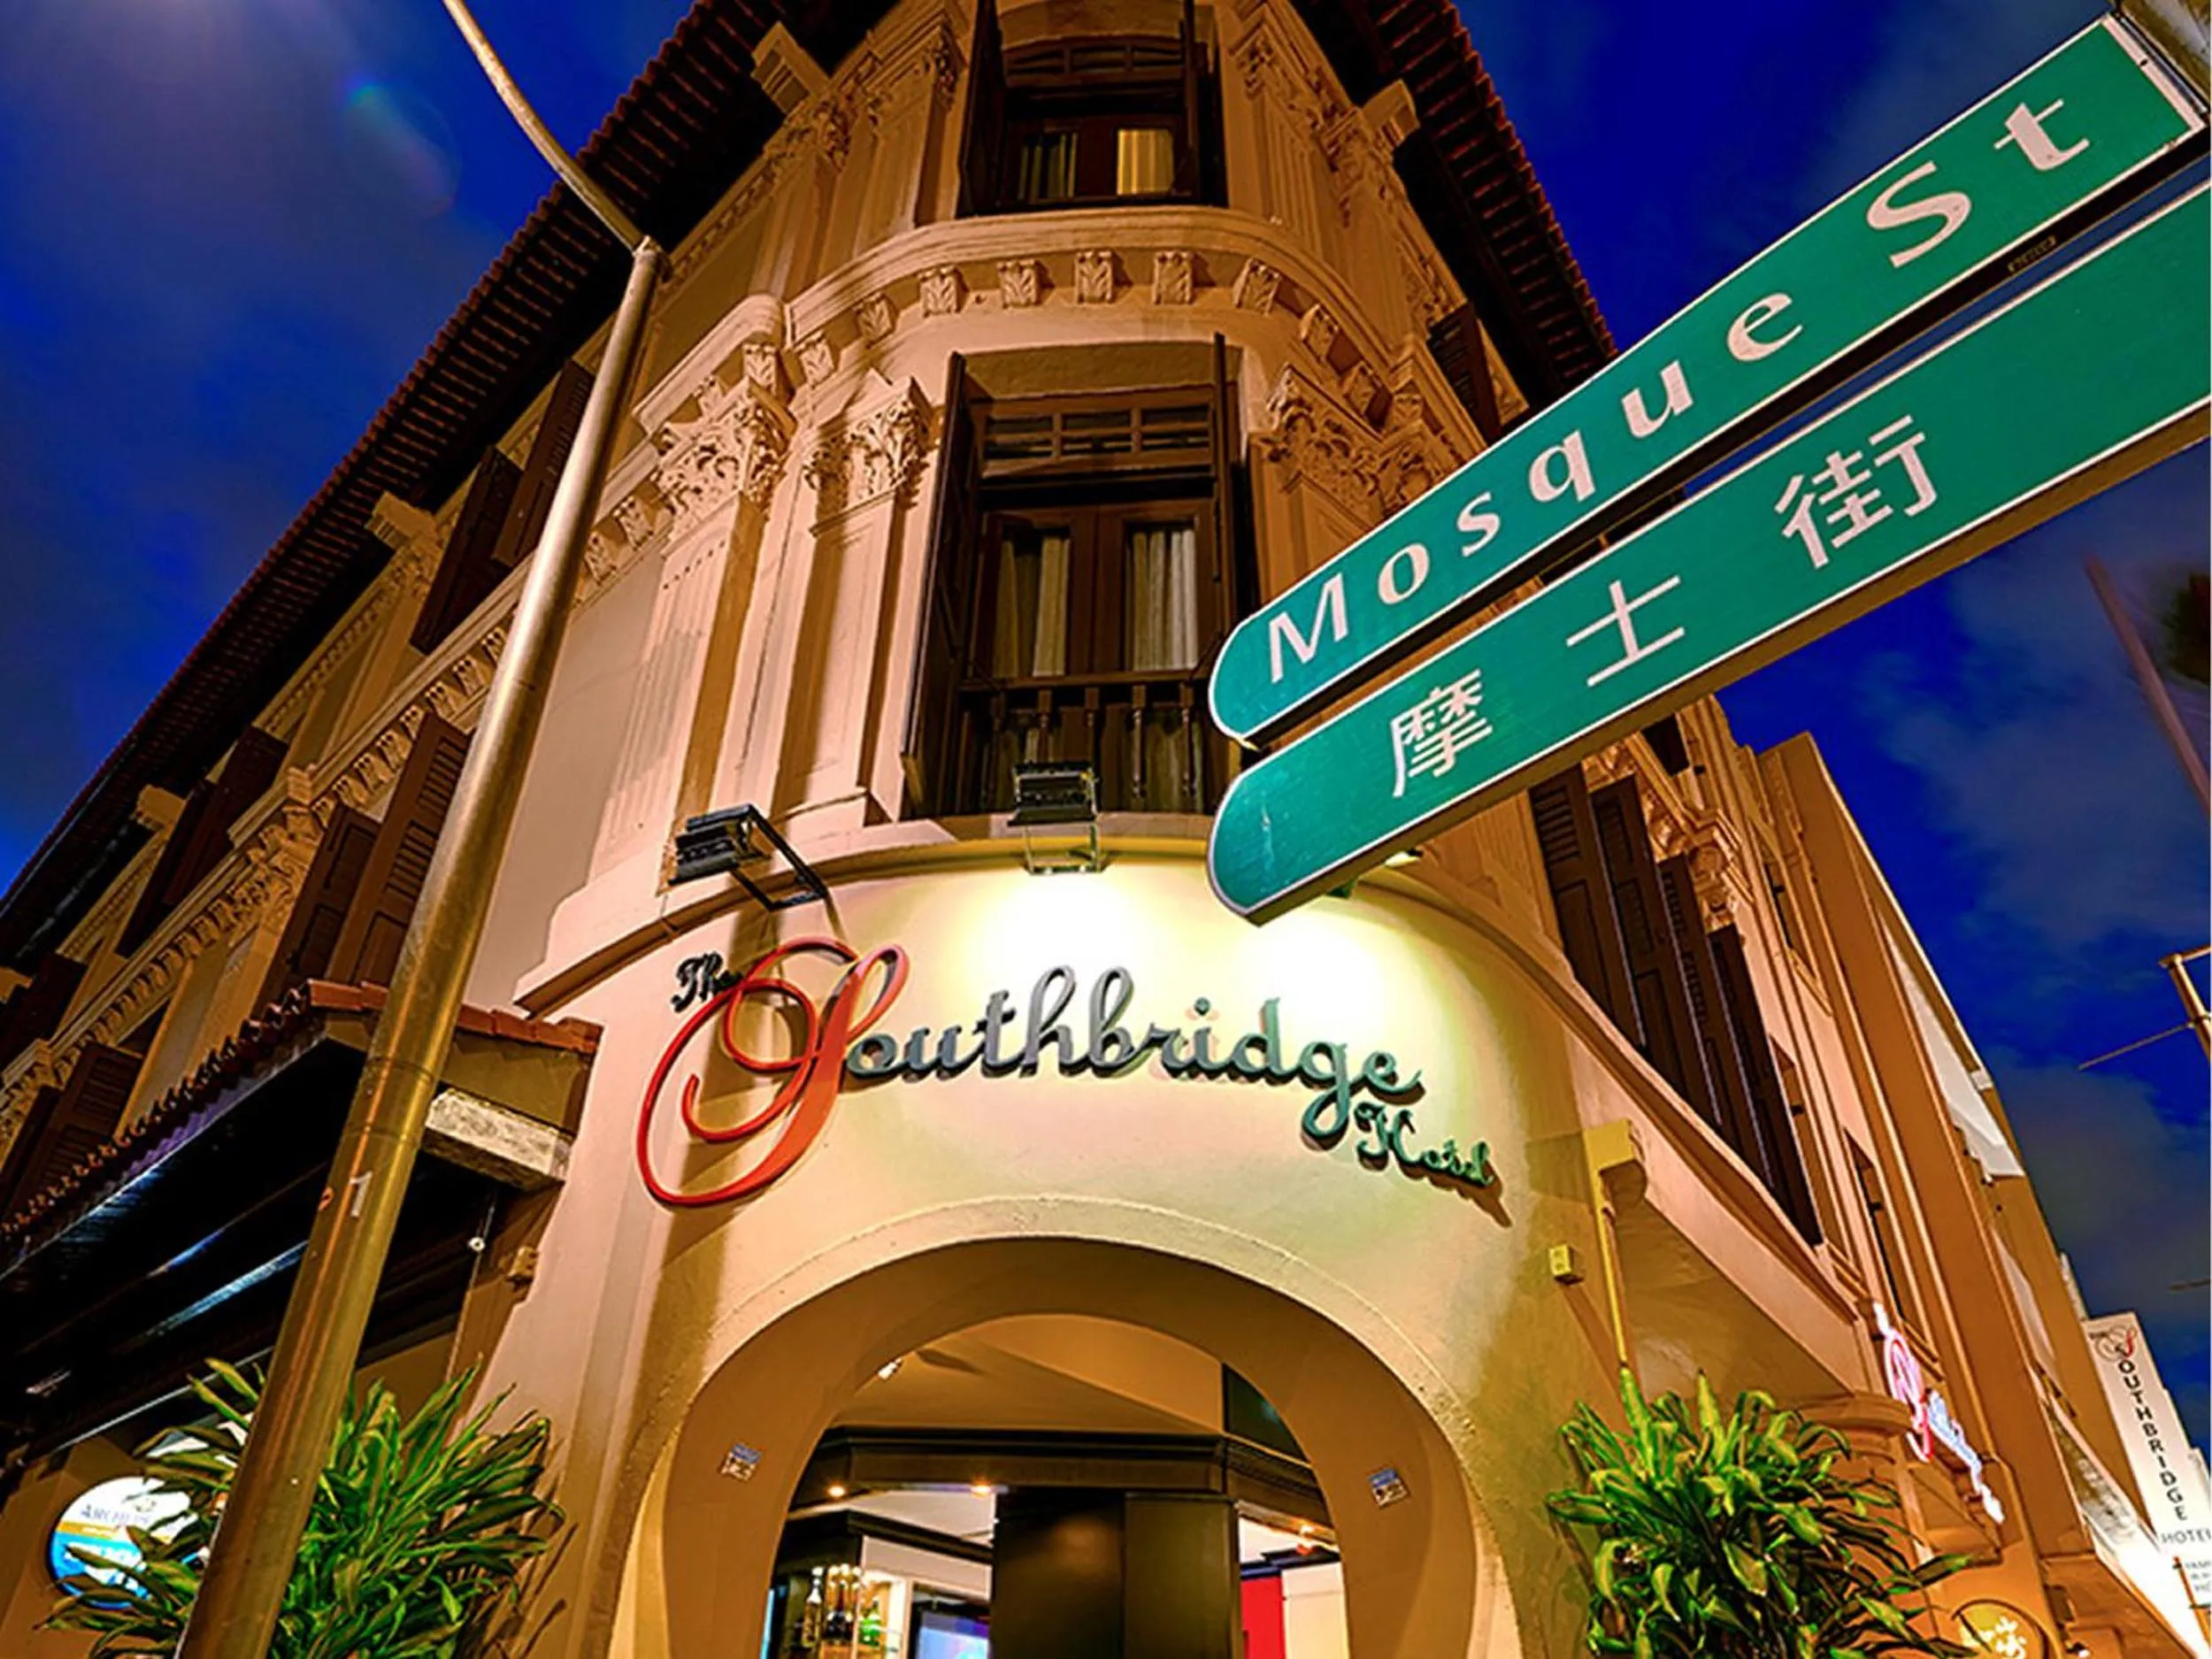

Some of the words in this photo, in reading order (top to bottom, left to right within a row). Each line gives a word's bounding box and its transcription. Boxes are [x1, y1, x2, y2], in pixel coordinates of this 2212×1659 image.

[1268, 292, 1803, 684] Mosque
[1866, 98, 2090, 268] St
[1390, 414, 1938, 798] 摩士街
[636, 935, 1423, 1207] Southbridge
[671, 950, 745, 1012] The
[1354, 1102, 1494, 1187] Hotel
